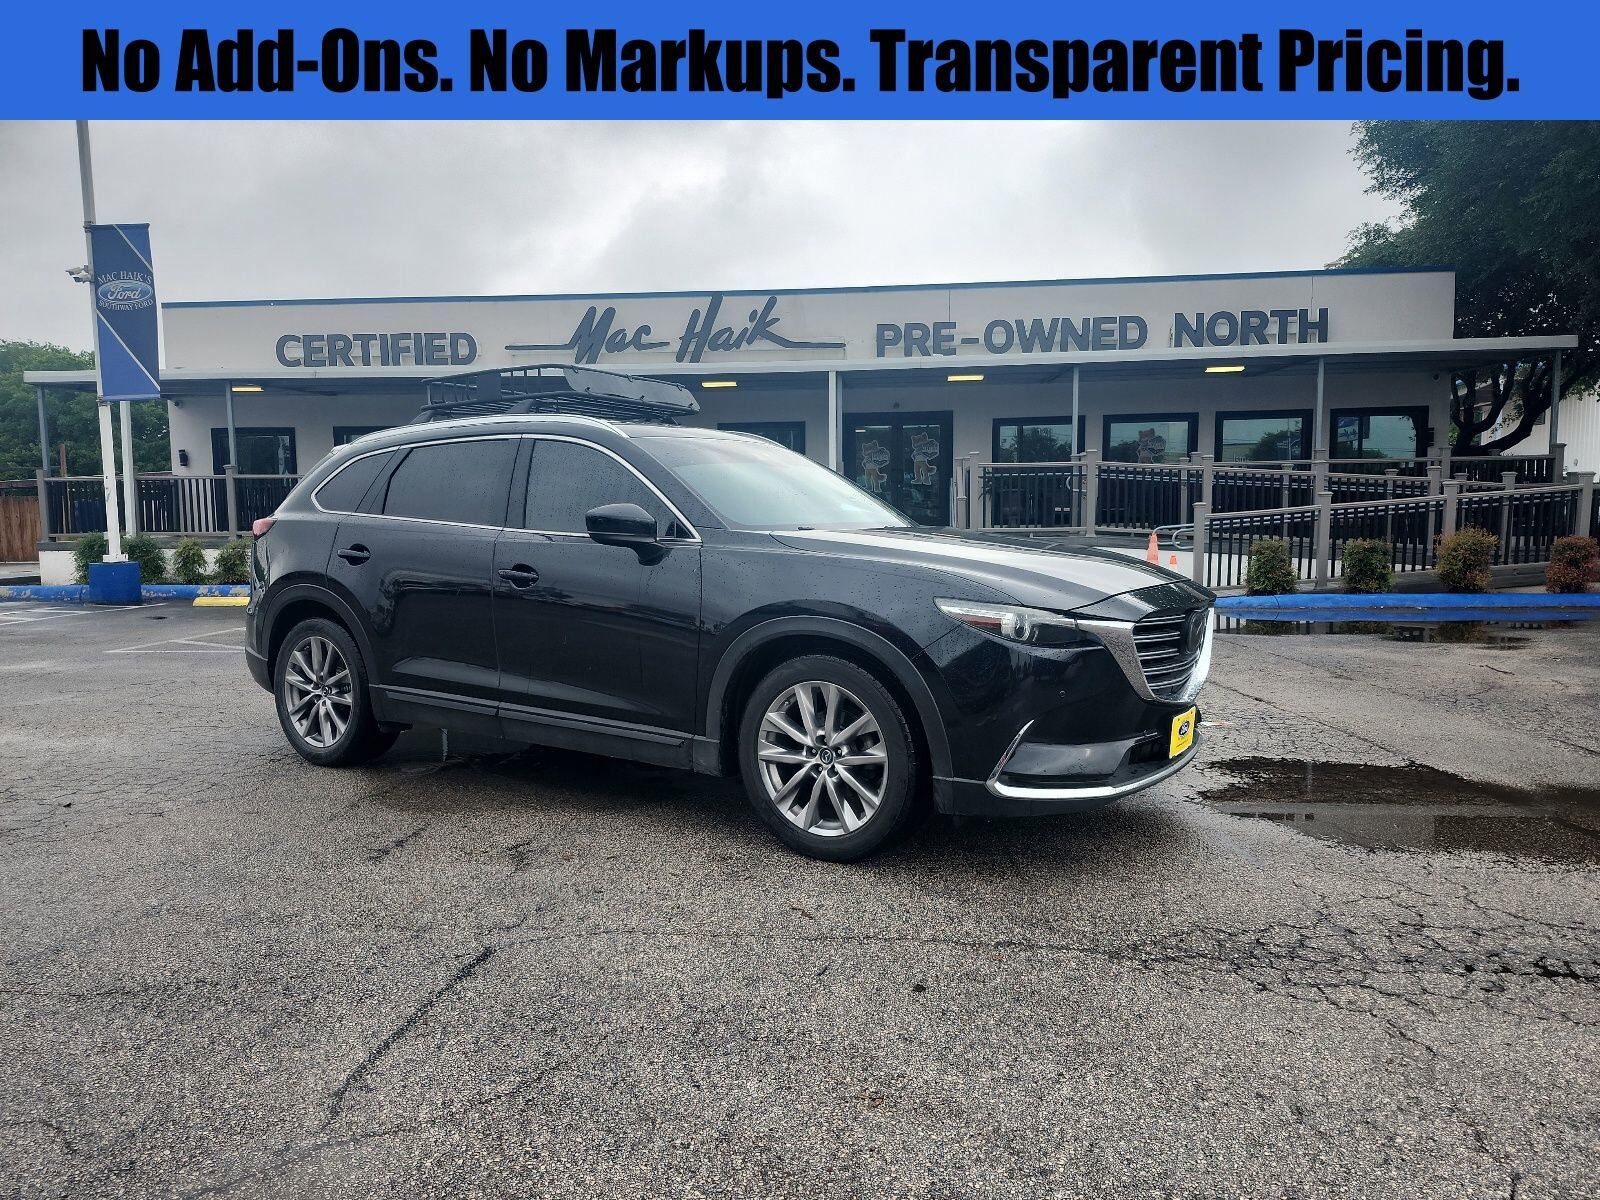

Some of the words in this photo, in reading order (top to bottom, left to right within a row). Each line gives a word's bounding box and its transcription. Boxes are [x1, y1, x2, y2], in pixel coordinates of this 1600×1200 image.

[97, 271, 118, 285] MAC
[107, 284, 142, 300] Ford
[275, 332, 478, 368] CERTIFIED
[566, 305, 671, 365] Mac
[675, 292, 800, 364] Haik
[876, 315, 1148, 358] PRE-OWNED
[1173, 307, 1329, 348] NORTH
